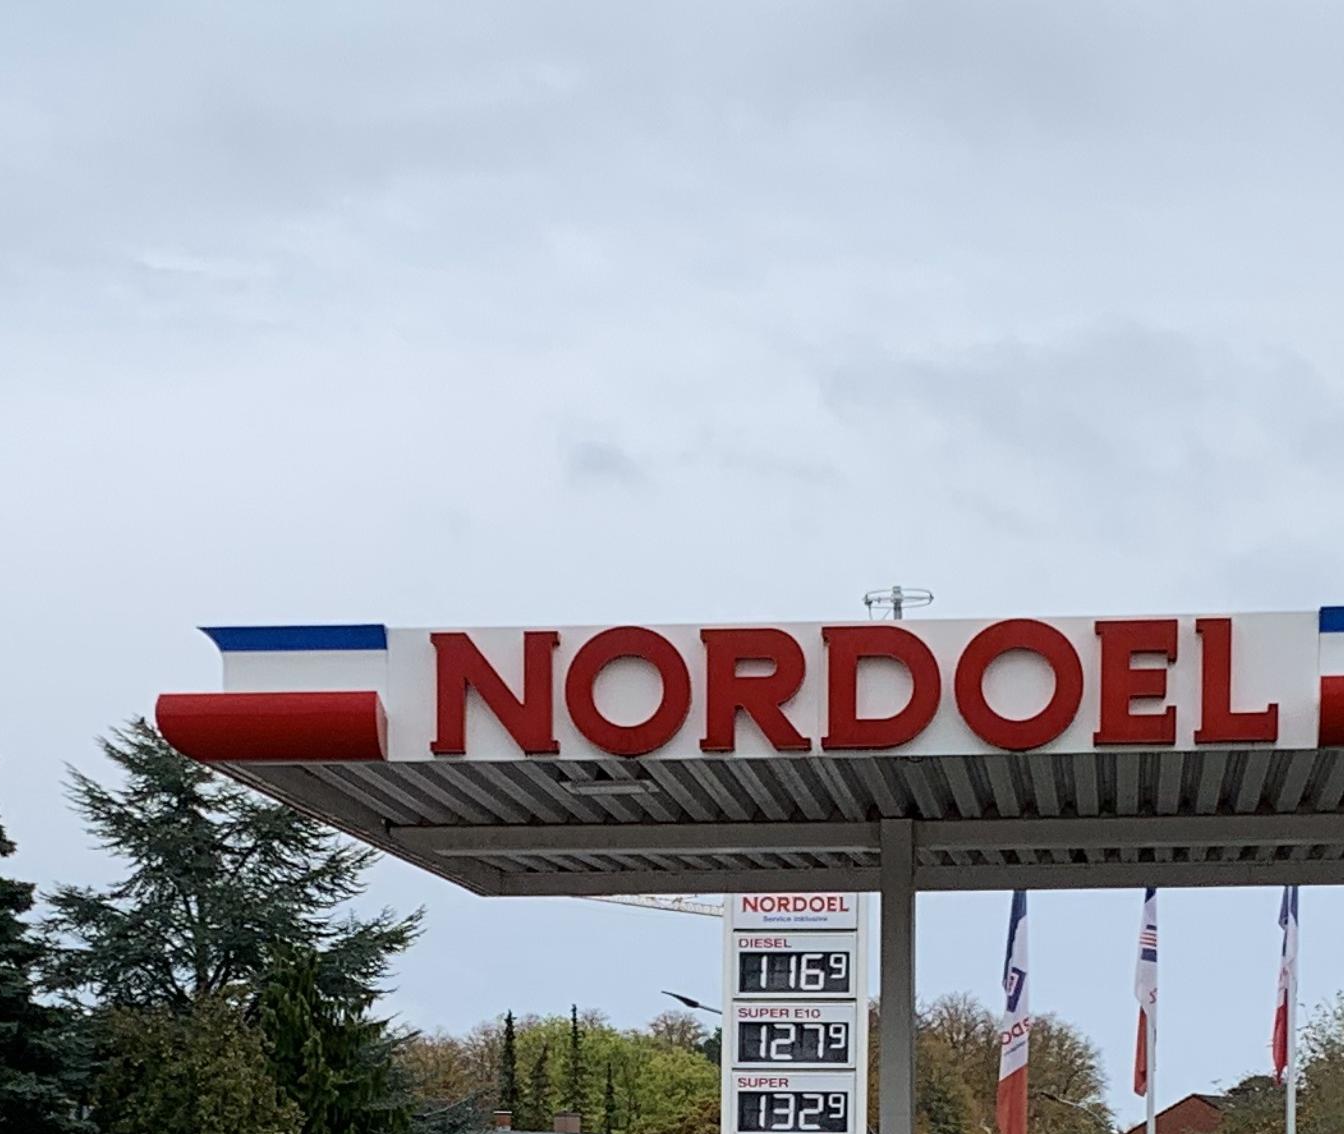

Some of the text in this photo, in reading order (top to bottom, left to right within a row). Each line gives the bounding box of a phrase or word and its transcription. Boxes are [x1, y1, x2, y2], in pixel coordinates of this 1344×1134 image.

[430, 618, 1279, 756] NORDOEL
[742, 896, 850, 912] NORDOEL
[738, 938, 792, 948] DIESEL
[738, 1008, 821, 1018] SUPER E10
[737, 1077, 789, 1088] SUPER
